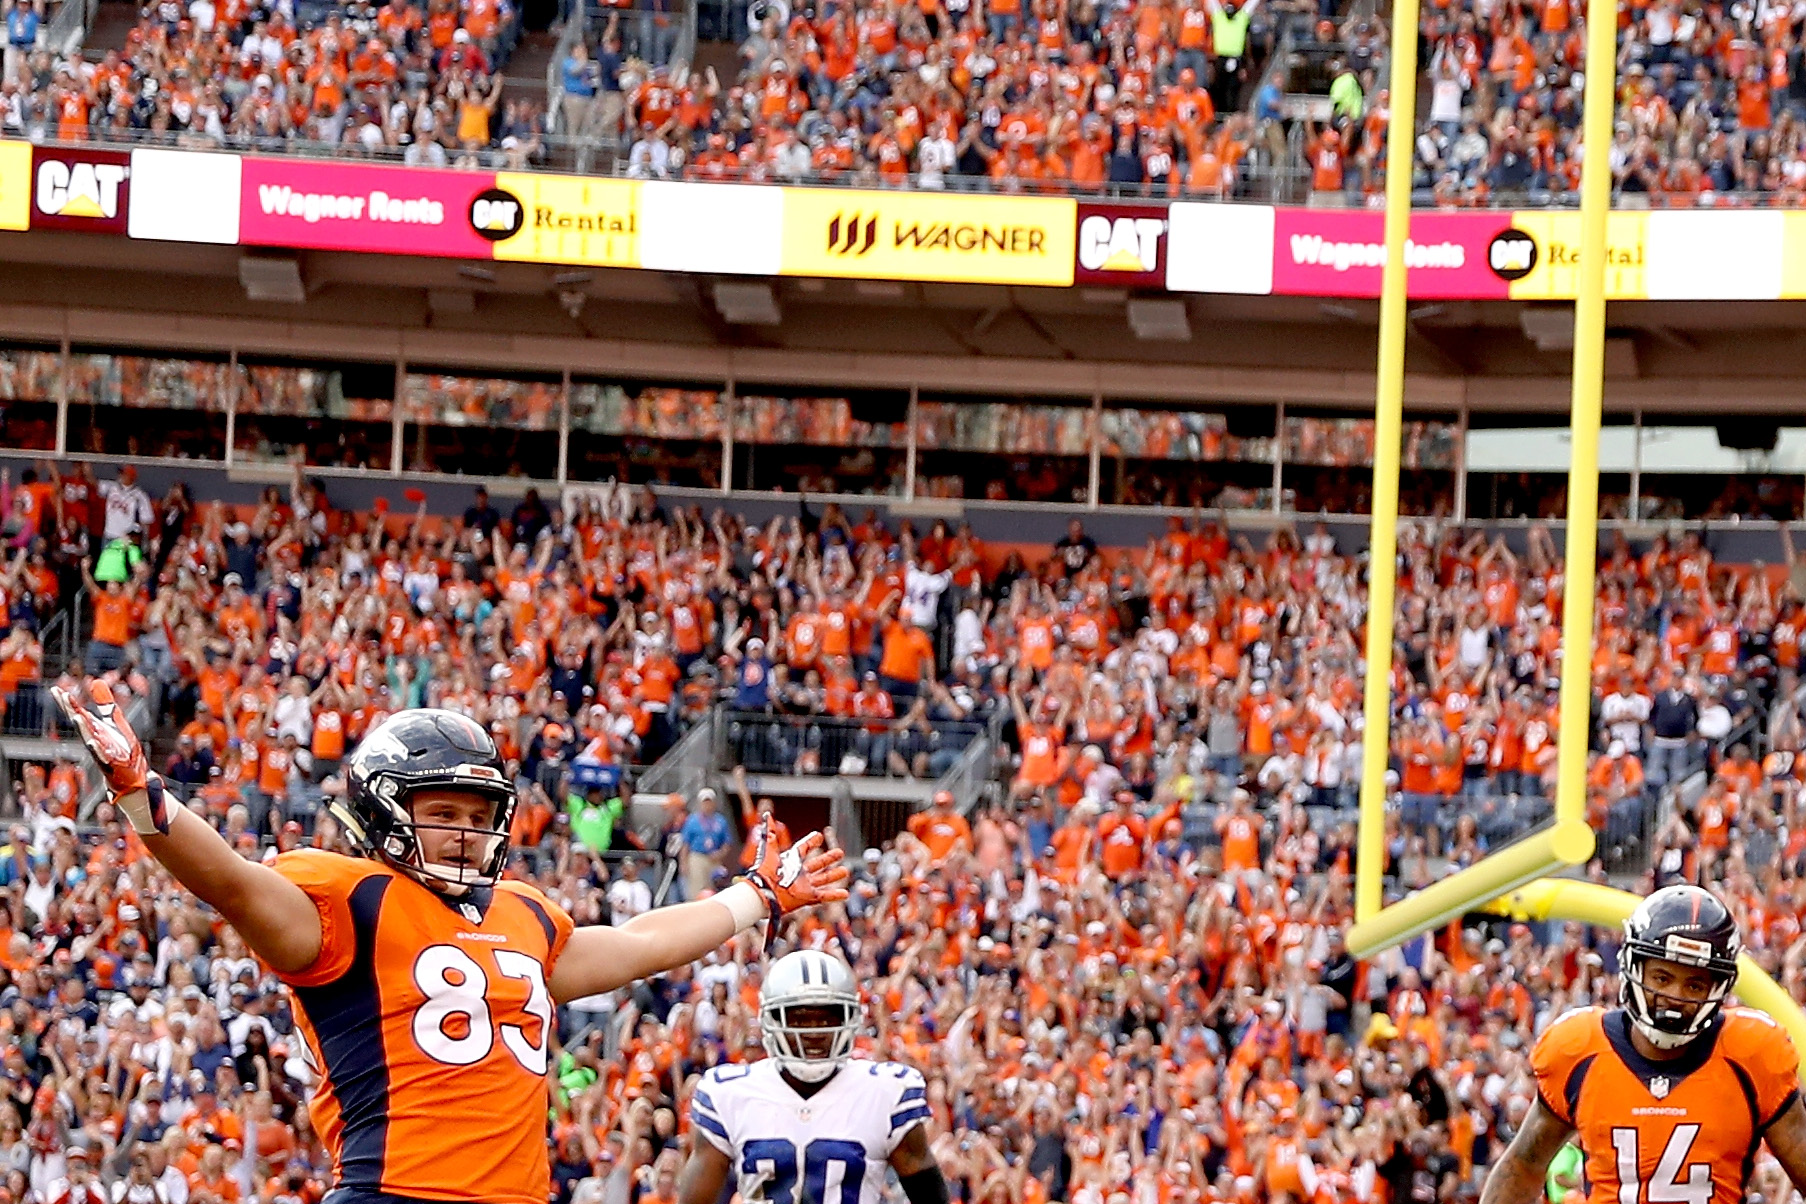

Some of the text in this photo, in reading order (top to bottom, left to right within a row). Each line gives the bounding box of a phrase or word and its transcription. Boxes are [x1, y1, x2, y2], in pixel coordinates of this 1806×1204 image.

[36, 159, 127, 219] CAT
[259, 184, 444, 225] Wagner Rents
[472, 199, 637, 233] CAT Rental
[894, 221, 1046, 254] WAGNER
[1079, 215, 1164, 272] CAT
[1490, 239, 1533, 270] CAT
[413, 944, 553, 1076] 83
[1631, 1107, 1688, 1116] BRONCOS
